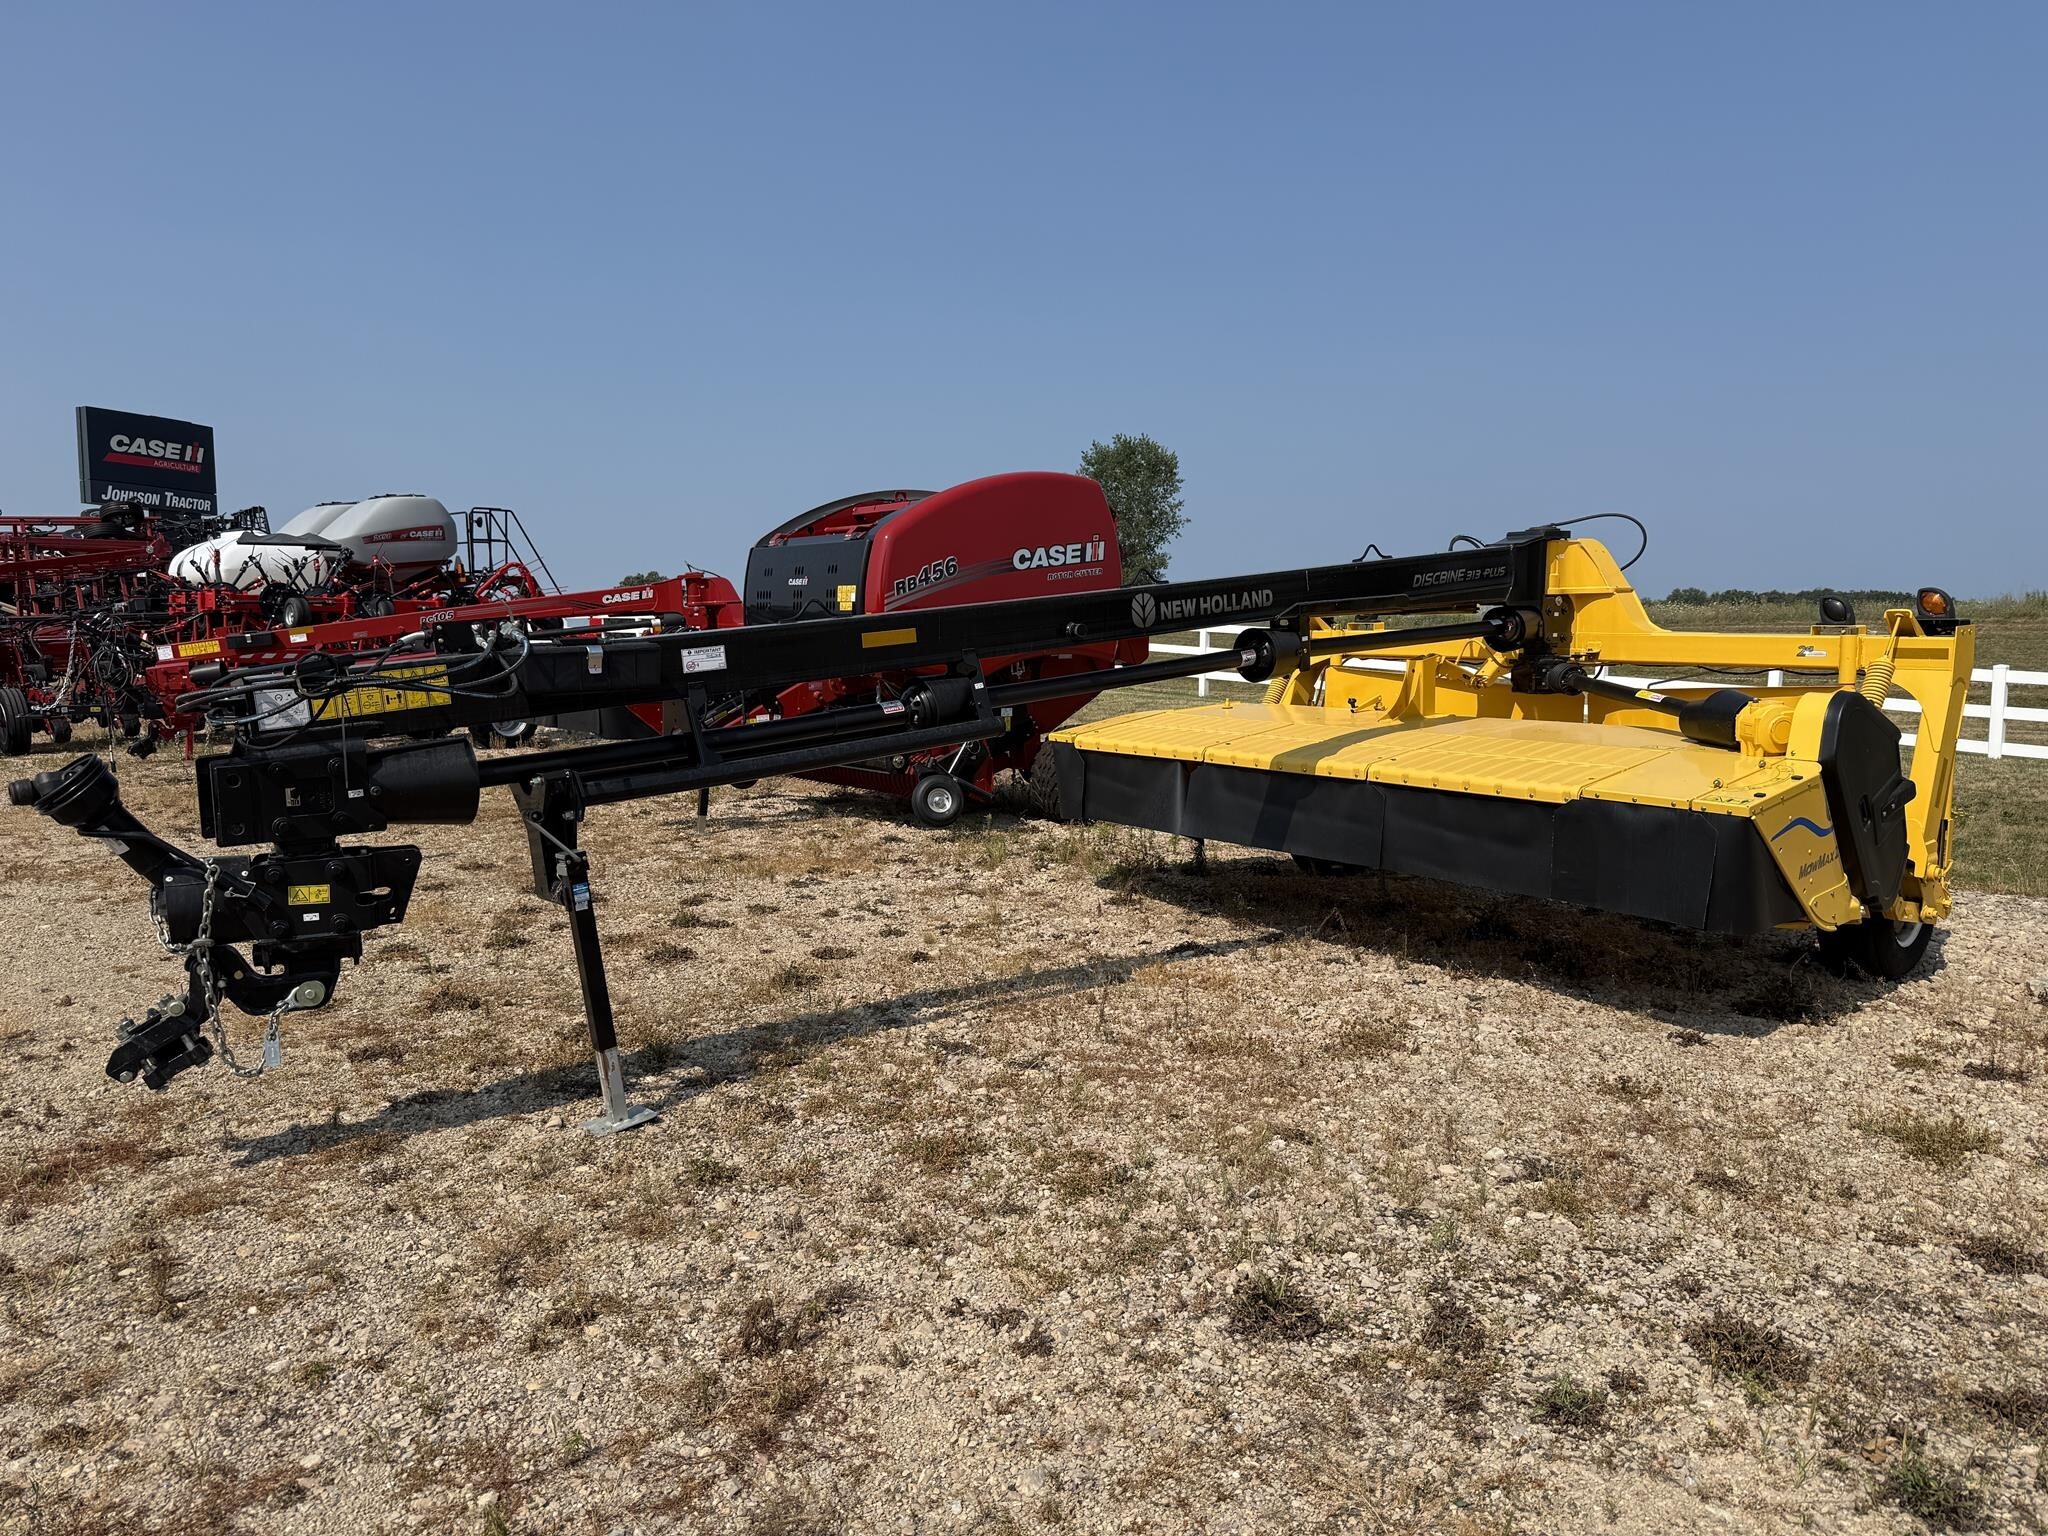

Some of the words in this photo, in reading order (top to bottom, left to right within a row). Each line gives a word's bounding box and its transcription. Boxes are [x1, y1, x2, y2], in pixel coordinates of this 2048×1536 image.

[110, 434, 182, 460] CASE
[153, 460, 200, 473] AGRICULTURE
[410, 530, 434, 538] CASE
[1012, 543, 1082, 570] CASE
[894, 555, 959, 597] RB456
[1047, 571, 1074, 581] ROTOR
[1074, 567, 1104, 578] CUTTER
[1412, 569, 1466, 588] DISCBINE
[1465, 570, 1481, 581] 313
[1483, 566, 1506, 578] PLUS
[602, 591, 640, 604] CASE
[1159, 597, 1197, 620] NEW
[1199, 589, 1274, 615] HOLLAND
